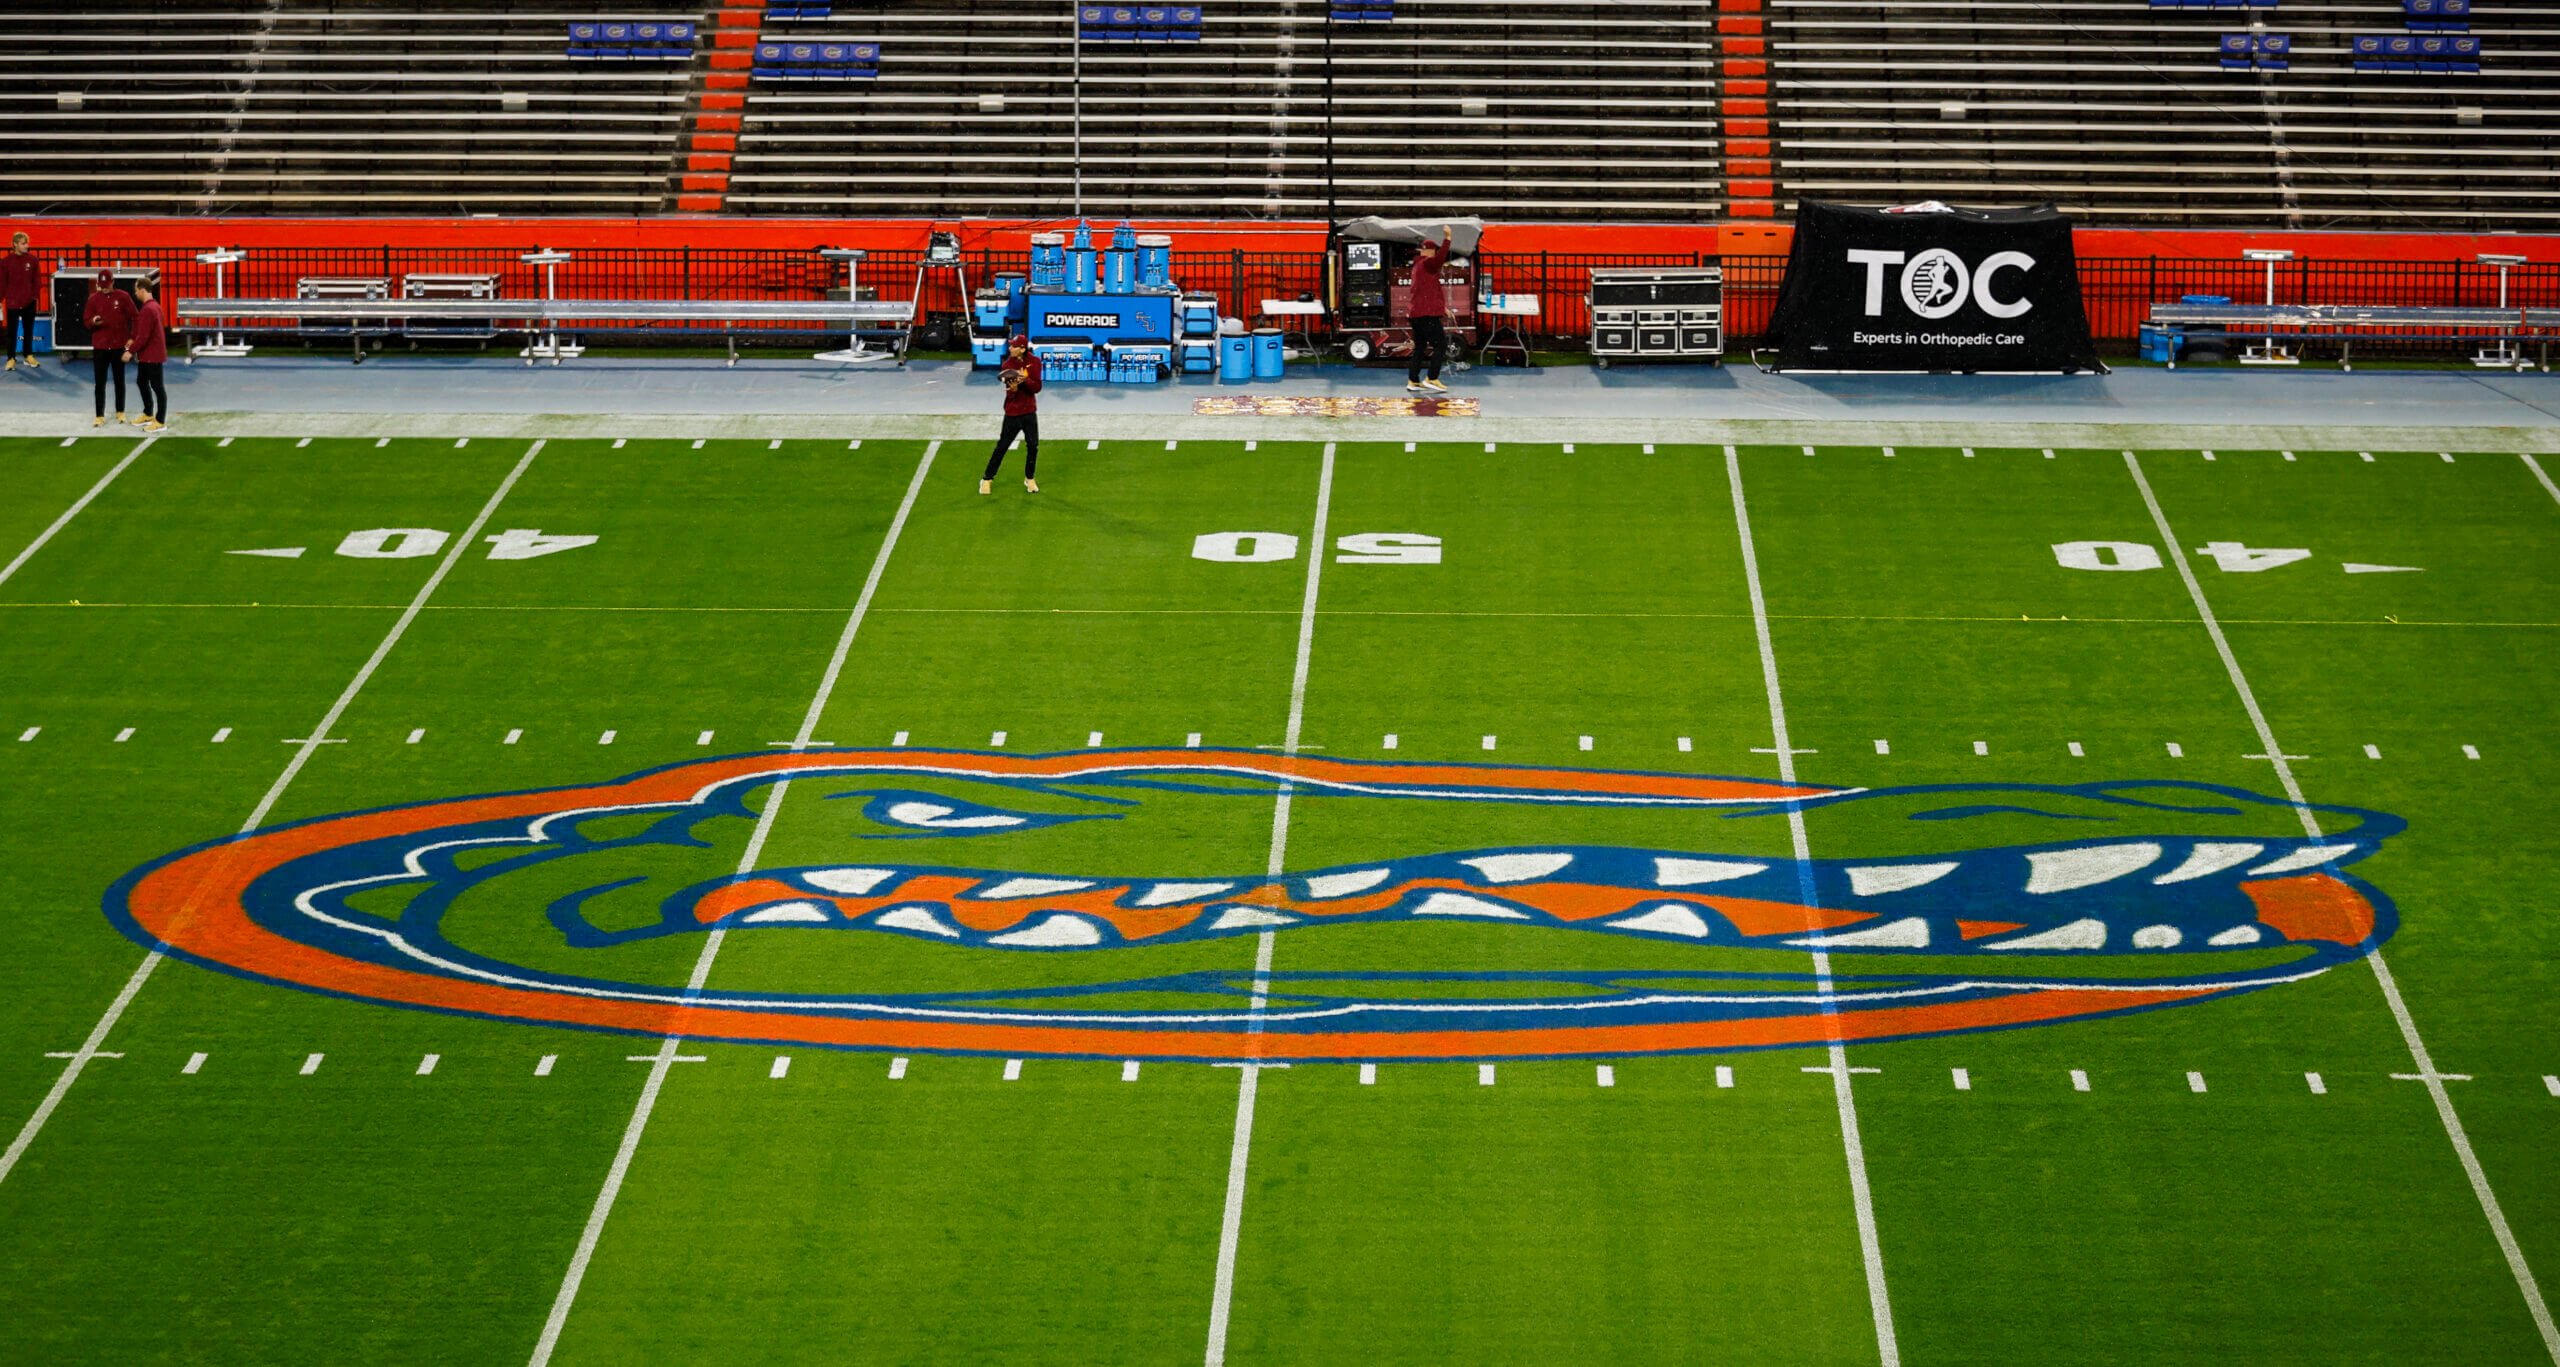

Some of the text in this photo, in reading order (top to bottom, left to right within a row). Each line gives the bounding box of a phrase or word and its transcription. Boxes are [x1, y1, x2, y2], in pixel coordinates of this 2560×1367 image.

[1847, 248, 2036, 319] TOC
[1046, 314, 1119, 327] POWERADE
[1853, 331, 2025, 348] Experts in Orthopedic Care
